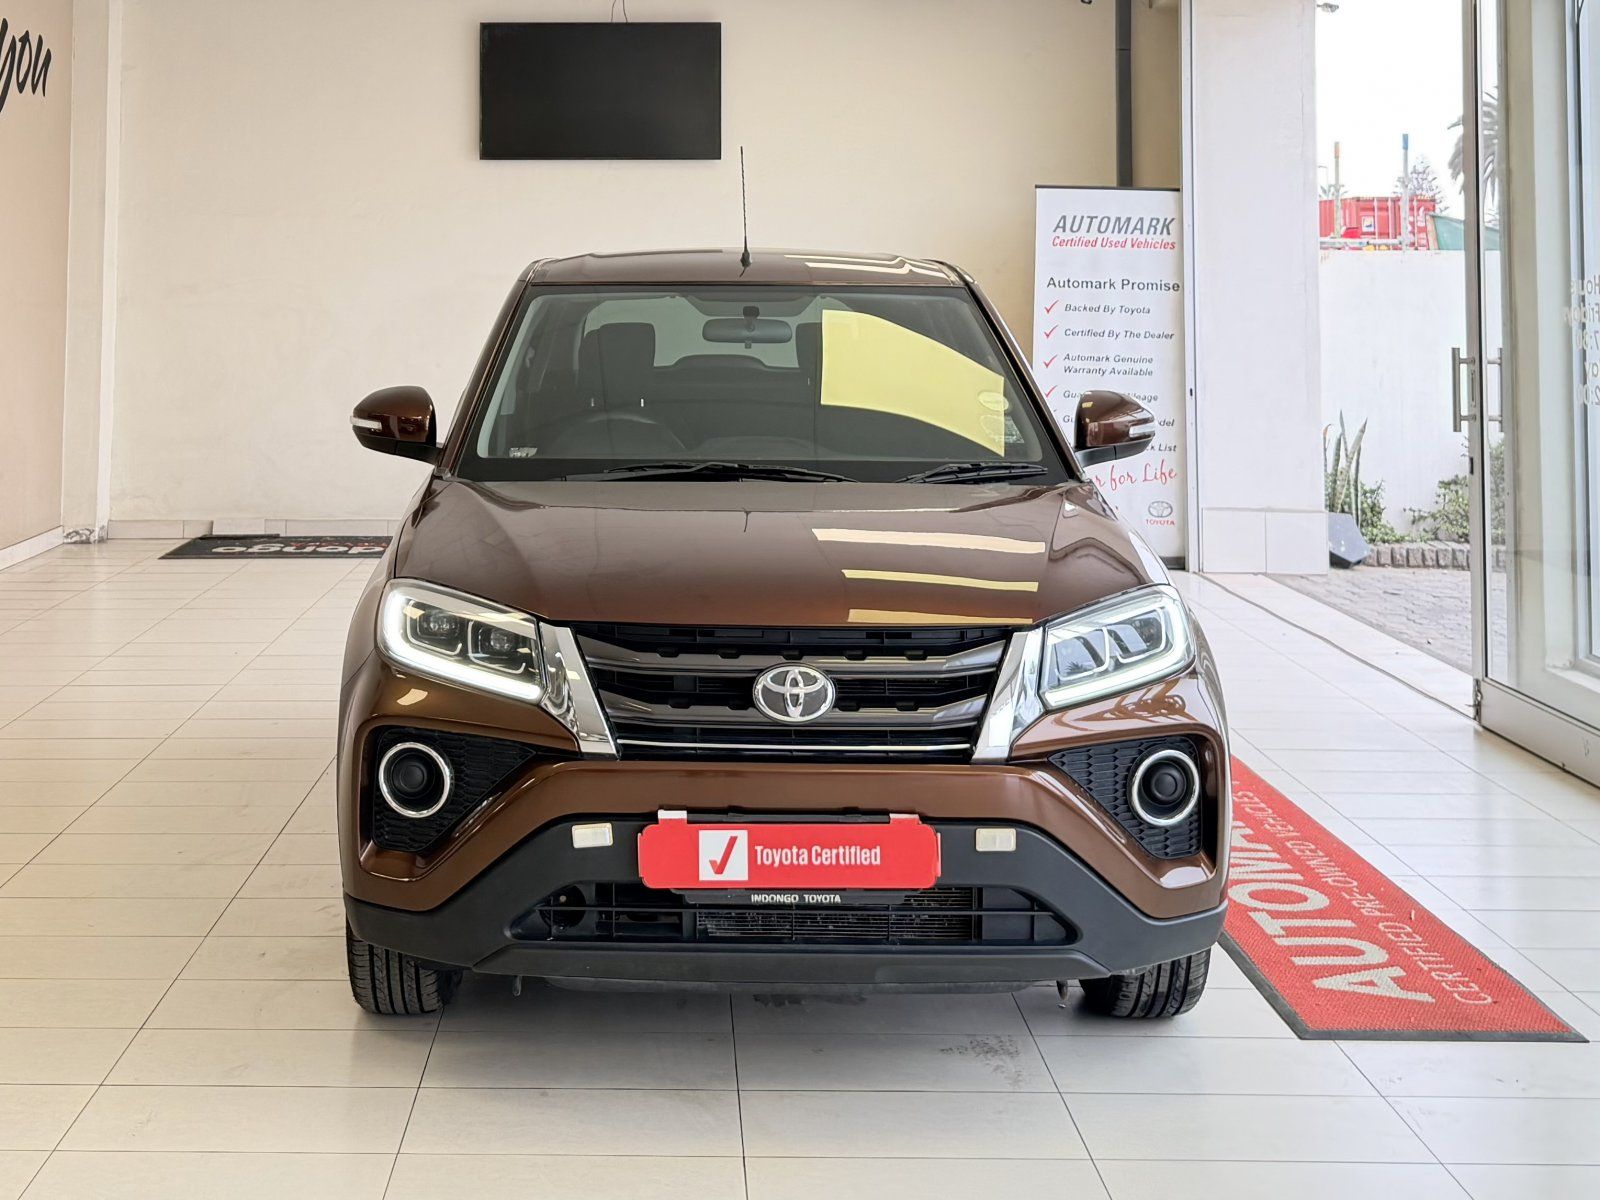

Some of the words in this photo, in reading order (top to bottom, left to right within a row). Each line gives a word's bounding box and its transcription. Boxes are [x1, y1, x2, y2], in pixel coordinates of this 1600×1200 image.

[1053, 215, 1176, 236] AUTOMARK
[1052, 236, 1099, 248] Certified
[1101, 237, 1127, 249] Used
[1130, 238, 1176, 250] Vehicles
[1047, 277, 1116, 290] Automark
[1121, 279, 1180, 292] Promise
[1064, 303, 1100, 313] Backed
[1103, 304, 1116, 315] By
[1119, 305, 1151, 316] Toyota
[1064, 328, 1105, 338] Certified
[1107, 329, 1120, 340] By
[1123, 330, 1141, 339] The
[1143, 330, 1175, 340] Dealer
[1063, 353, 1110, 363] Automark
[1113, 354, 1153, 364] Genuine
[1063, 365, 1107, 377] Warranty
[1109, 368, 1153, 377] Available
[1158, 443, 1177, 452] List
[1110, 464, 1137, 491] for
[1142, 459, 1178, 485] Life
[1145, 518, 1176, 526] TOYOTA
[754, 845, 809, 868] Toyota
[811, 845, 881, 866] Certified
[1284, 840, 1397, 917] PRE-OWNED
[750, 894, 799, 903] INDONGO
[803, 894, 842, 903] TOYOTA
[1377, 921, 1493, 1005] CERTIFIED
